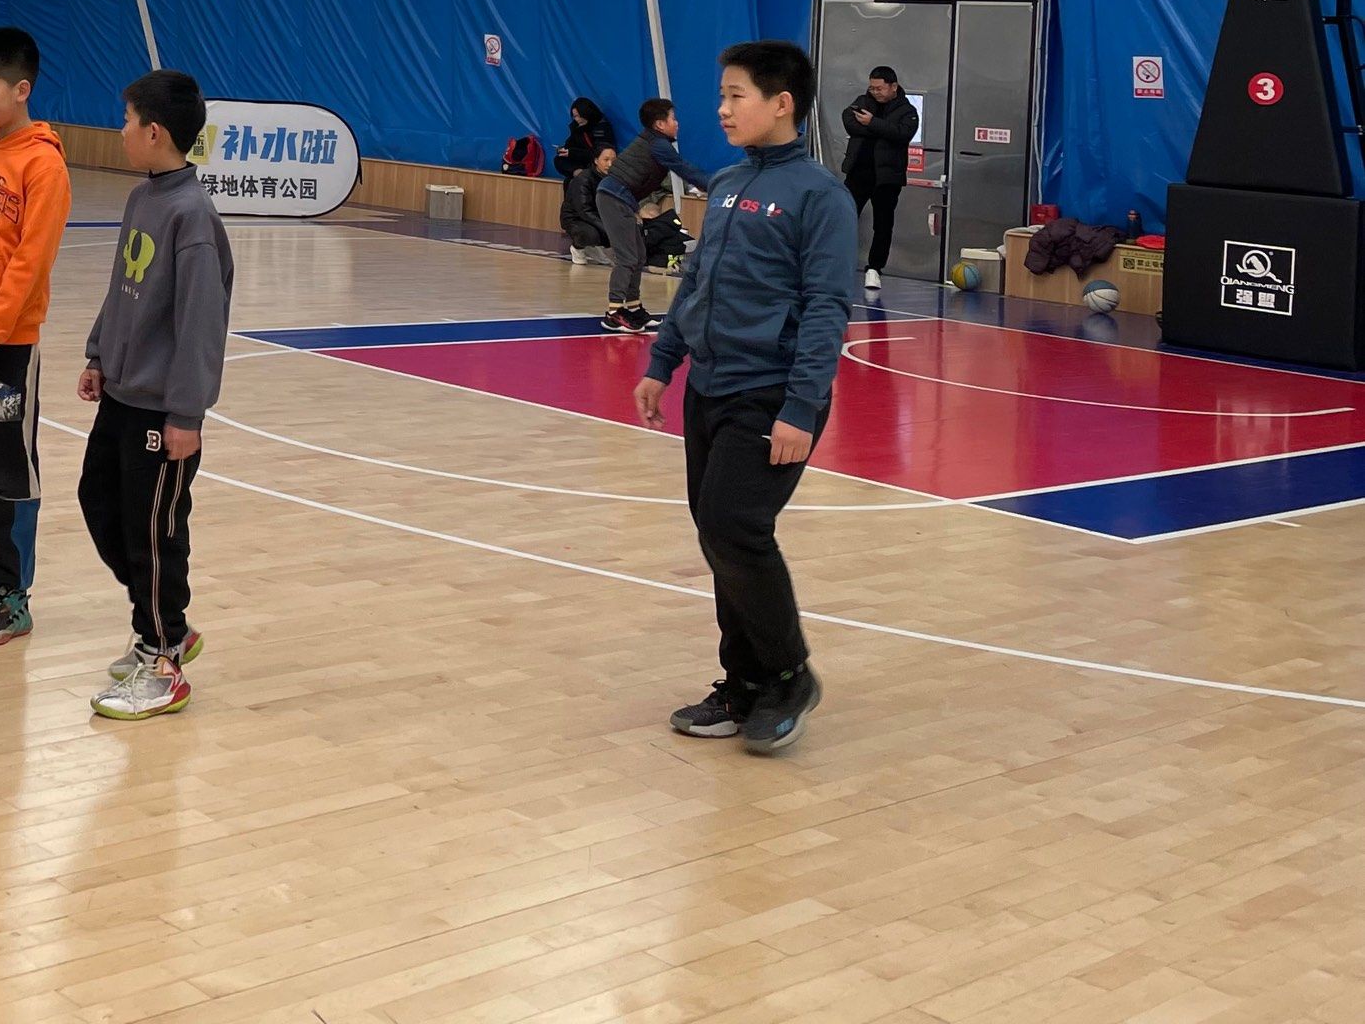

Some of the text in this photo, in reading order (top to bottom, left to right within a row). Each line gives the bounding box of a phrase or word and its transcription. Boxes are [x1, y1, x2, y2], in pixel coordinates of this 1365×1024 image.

[1256, 77, 1275, 101] 3
[221, 125, 338, 165] 补水啦
[201, 174, 317, 200] 绿地体育公园
[146, 429, 162, 452] B
